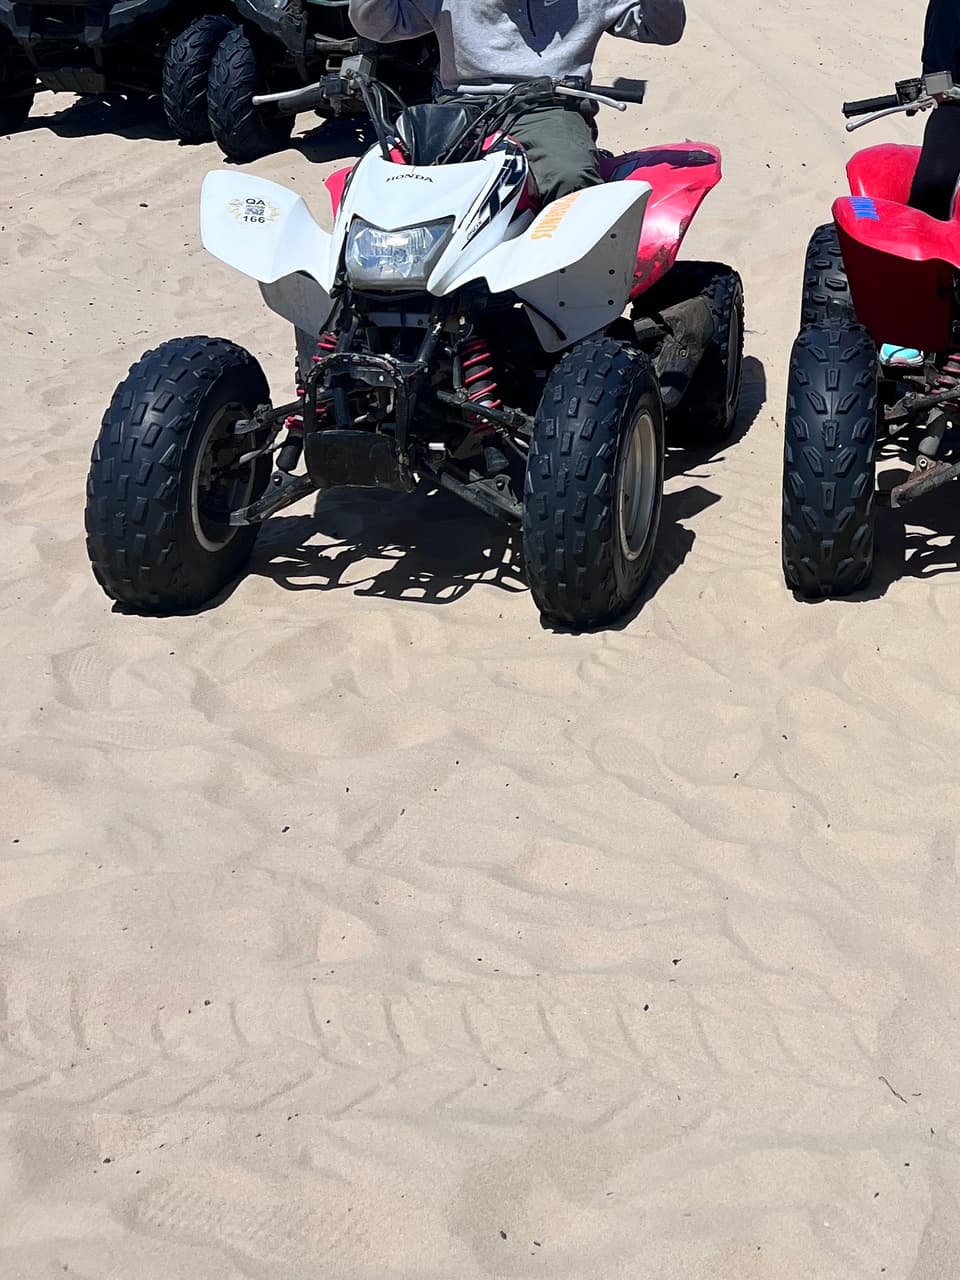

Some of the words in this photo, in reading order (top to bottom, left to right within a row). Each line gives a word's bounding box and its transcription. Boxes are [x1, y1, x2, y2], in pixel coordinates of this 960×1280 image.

[385, 173, 434, 183] HONDA
[245, 198, 266, 206] QA
[242, 215, 266, 224] 166
